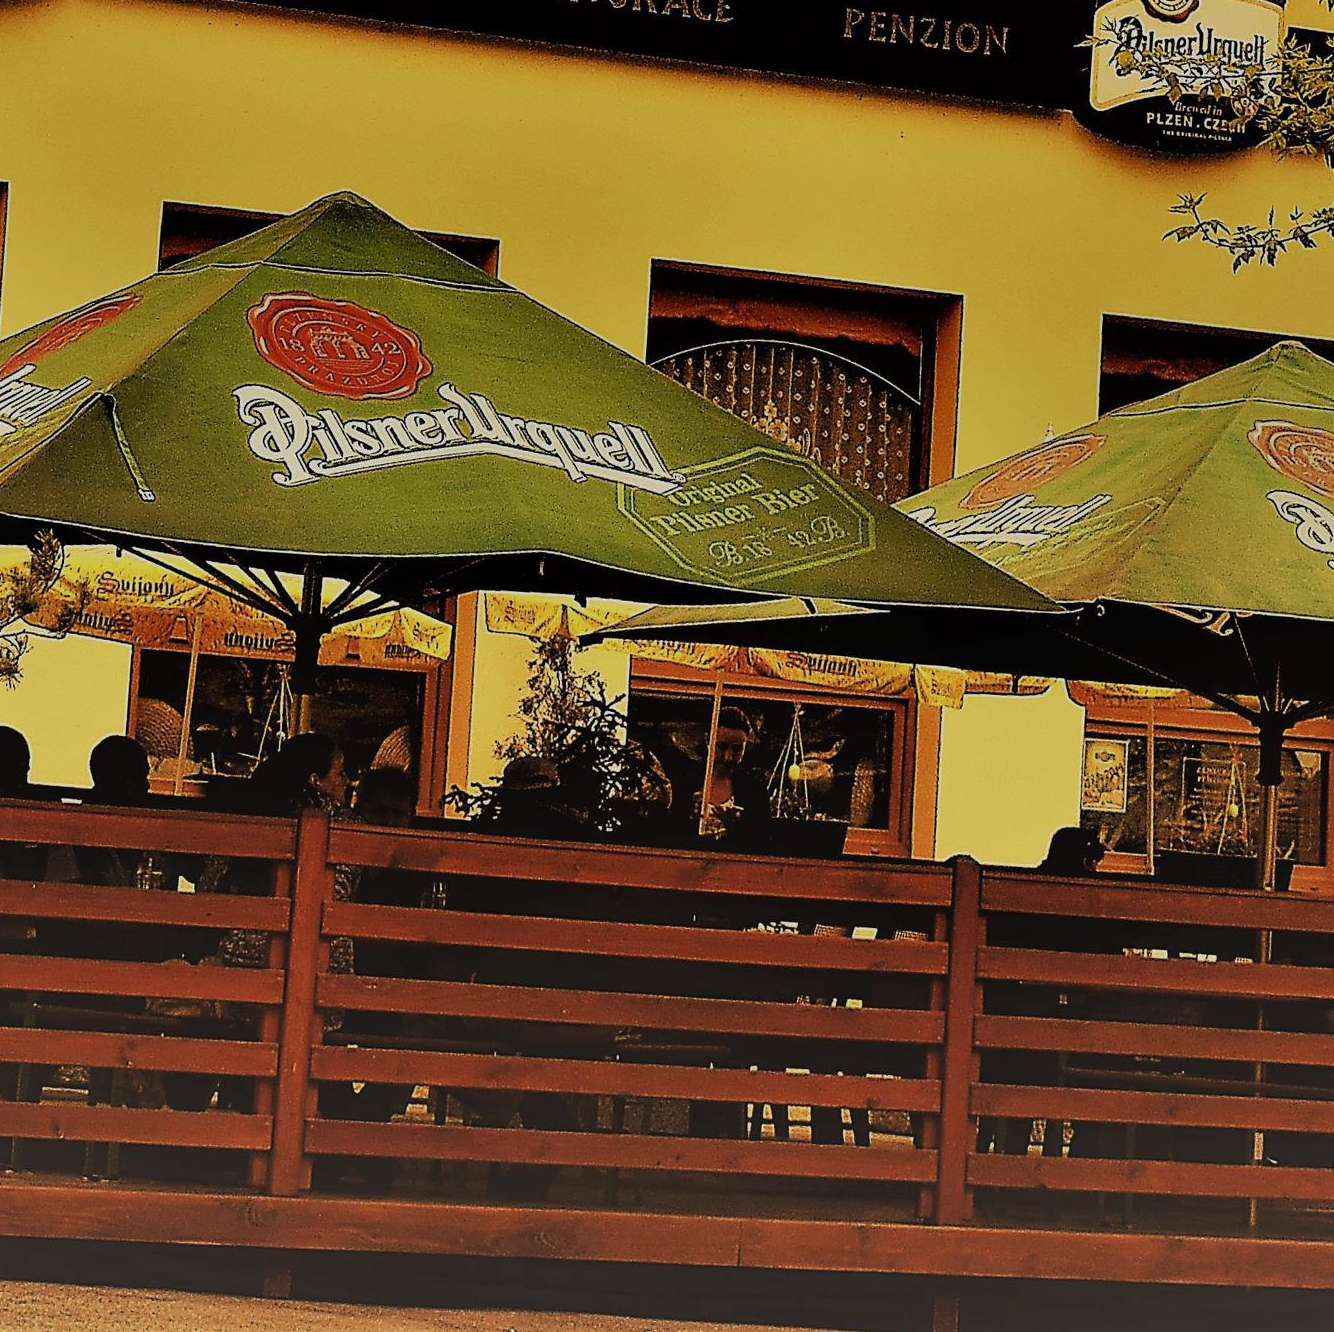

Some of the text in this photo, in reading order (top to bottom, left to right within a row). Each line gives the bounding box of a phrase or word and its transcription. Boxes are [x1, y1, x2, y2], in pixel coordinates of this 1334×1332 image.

[843, 8, 1009, 55] PENZION
[1213, 105, 1223, 116] in
[279, 337, 401, 356] 18 42
[232, 384, 672, 488] Pilsner Urquell
[650, 483, 819, 536] Pilsner Bier
